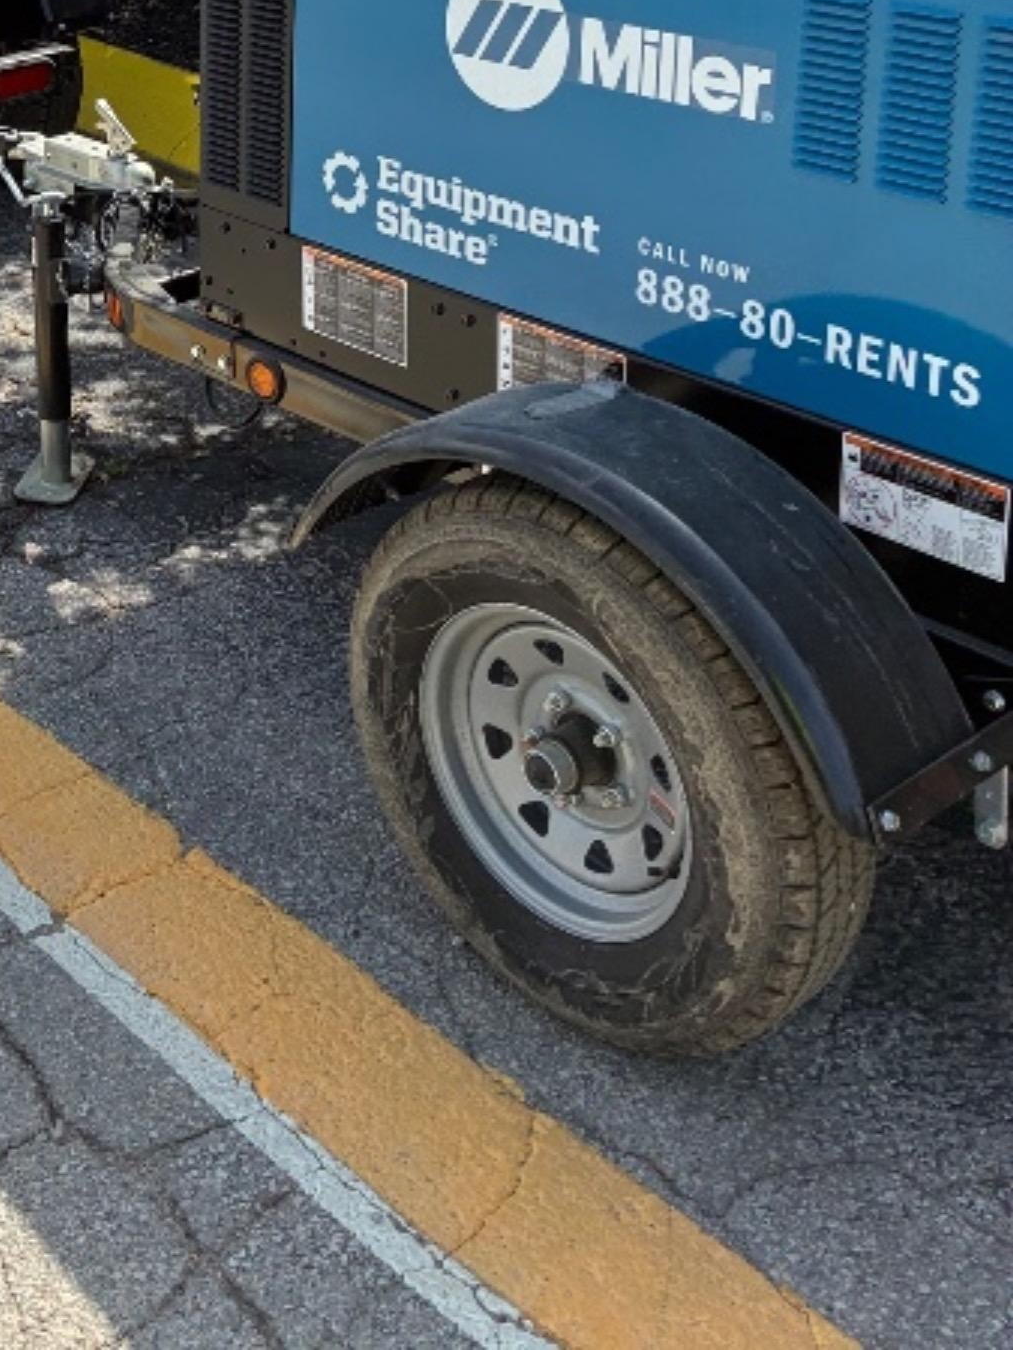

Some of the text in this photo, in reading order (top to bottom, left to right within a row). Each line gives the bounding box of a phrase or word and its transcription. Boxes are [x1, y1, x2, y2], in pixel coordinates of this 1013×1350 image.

[579, 17, 773, 123] Miller
[376, 154, 601, 254] Equipment
[376, 199, 489, 266] Share
[637, 236, 752, 284] CALL NOW
[634, 268, 982, 409] 888-80-RENTS
